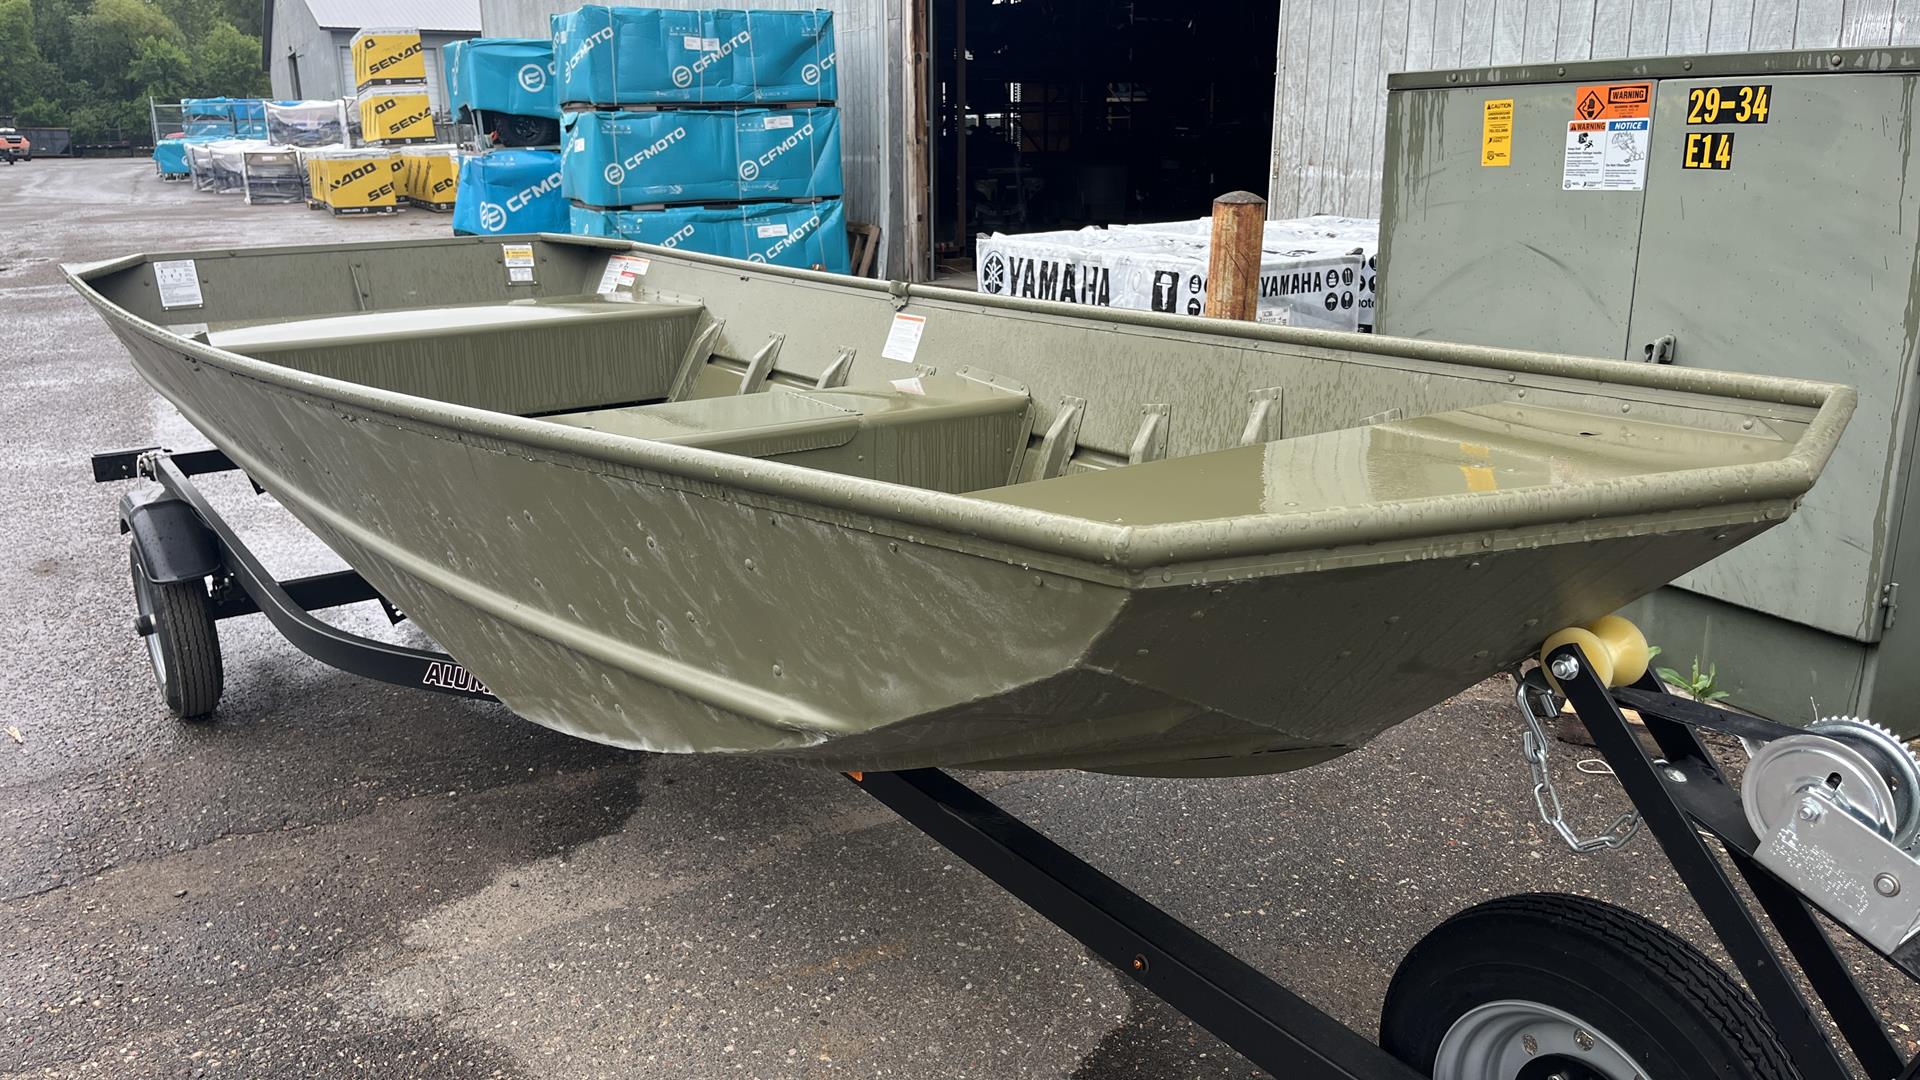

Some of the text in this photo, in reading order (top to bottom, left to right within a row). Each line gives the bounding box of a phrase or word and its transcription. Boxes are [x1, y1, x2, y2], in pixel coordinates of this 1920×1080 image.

[570, 26, 614, 70] CFMOTO
[692, 30, 751, 73] CFMOTO
[1612, 90, 1644, 100] WARNING
[1687, 86, 1768, 124] 29-34
[758, 123, 814, 167] CFMOTO
[1577, 122, 1606, 131] WARNING
[1614, 121, 1643, 130] NOTICE
[624, 126, 687, 170] CFMOTO
[1685, 133, 1731, 169] E14
[766, 215, 820, 259] CFMOTO
[1008, 256, 1111, 307] YAMAHA
[1261, 271, 1323, 298] YAMAHA
